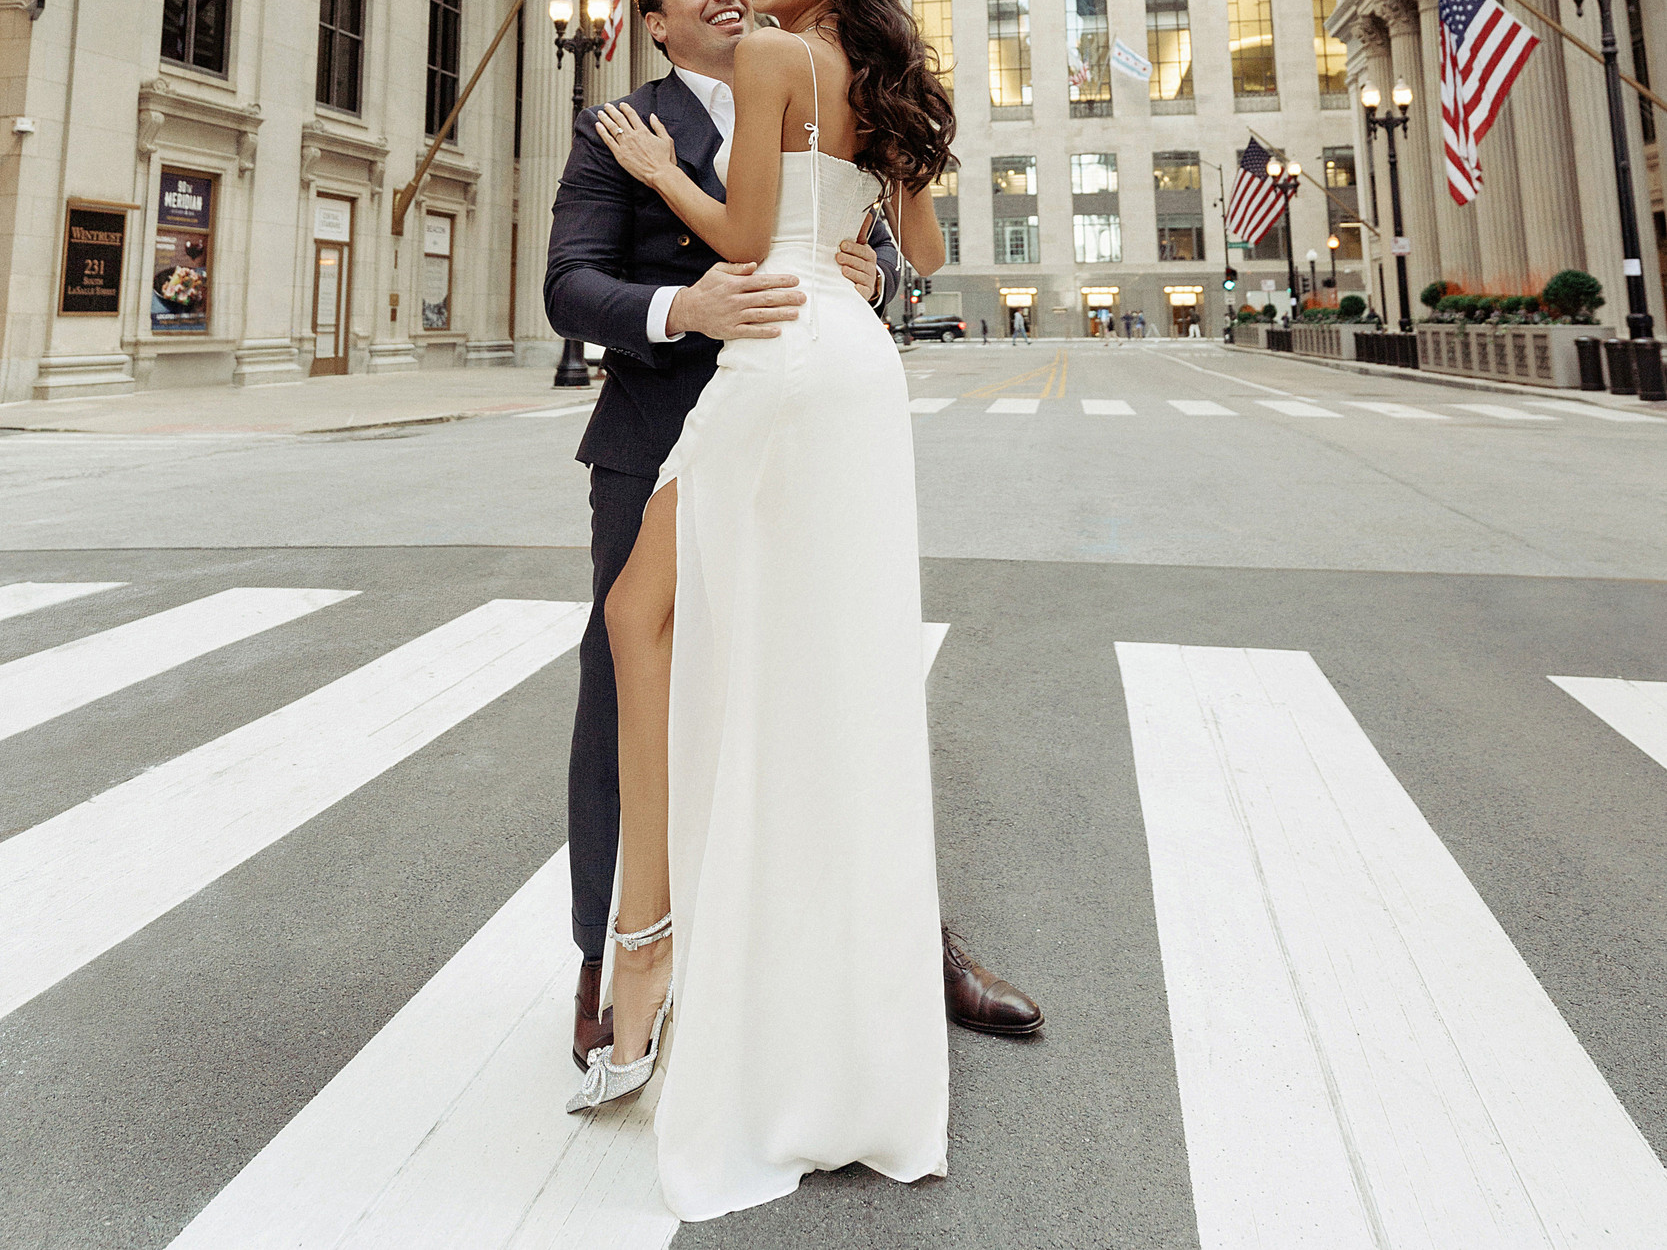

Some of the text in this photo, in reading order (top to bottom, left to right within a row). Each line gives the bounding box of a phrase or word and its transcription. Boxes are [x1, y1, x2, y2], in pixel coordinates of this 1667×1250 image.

[164, 191, 202, 211] MERIDIAN
[71, 226, 122, 243] WINTRUST
[84, 259, 105, 275] 231
